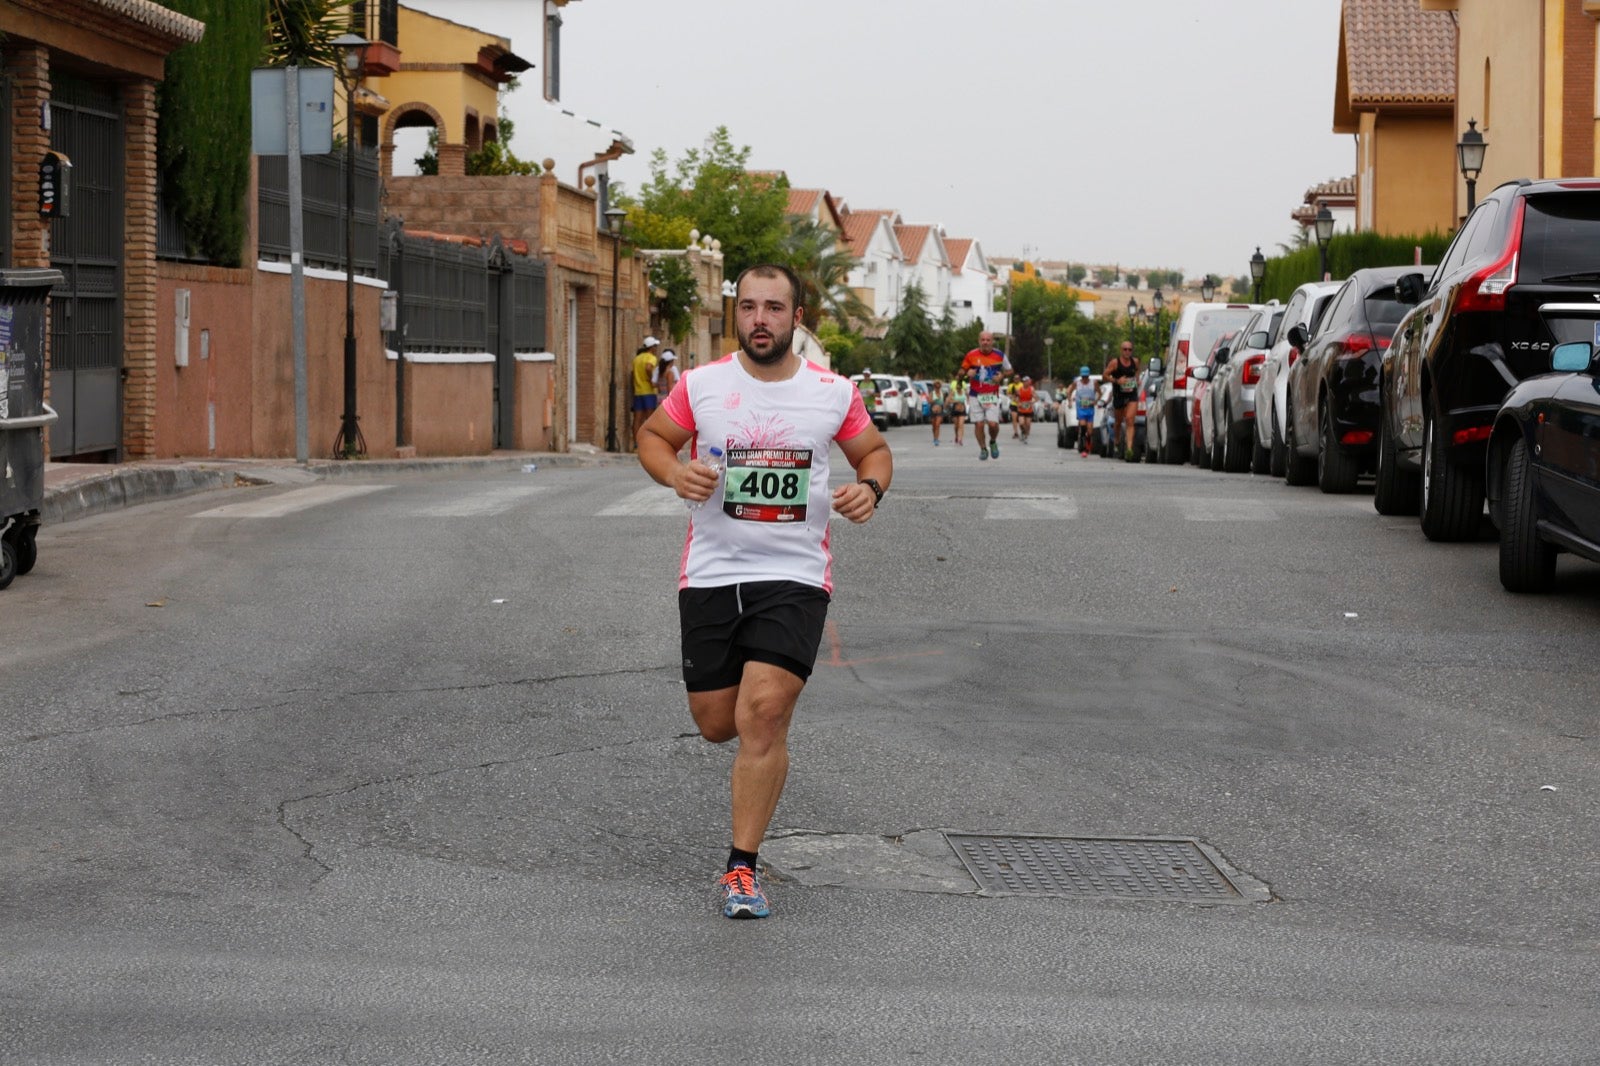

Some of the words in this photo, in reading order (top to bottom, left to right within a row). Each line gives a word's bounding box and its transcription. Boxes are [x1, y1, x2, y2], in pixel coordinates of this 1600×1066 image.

[747, 450, 762, 460] GRAN
[763, 450, 784, 460] PREMIO
[785, 451, 792, 461] DE
[793, 451, 809, 461] FONDO
[739, 471, 799, 500] 408
